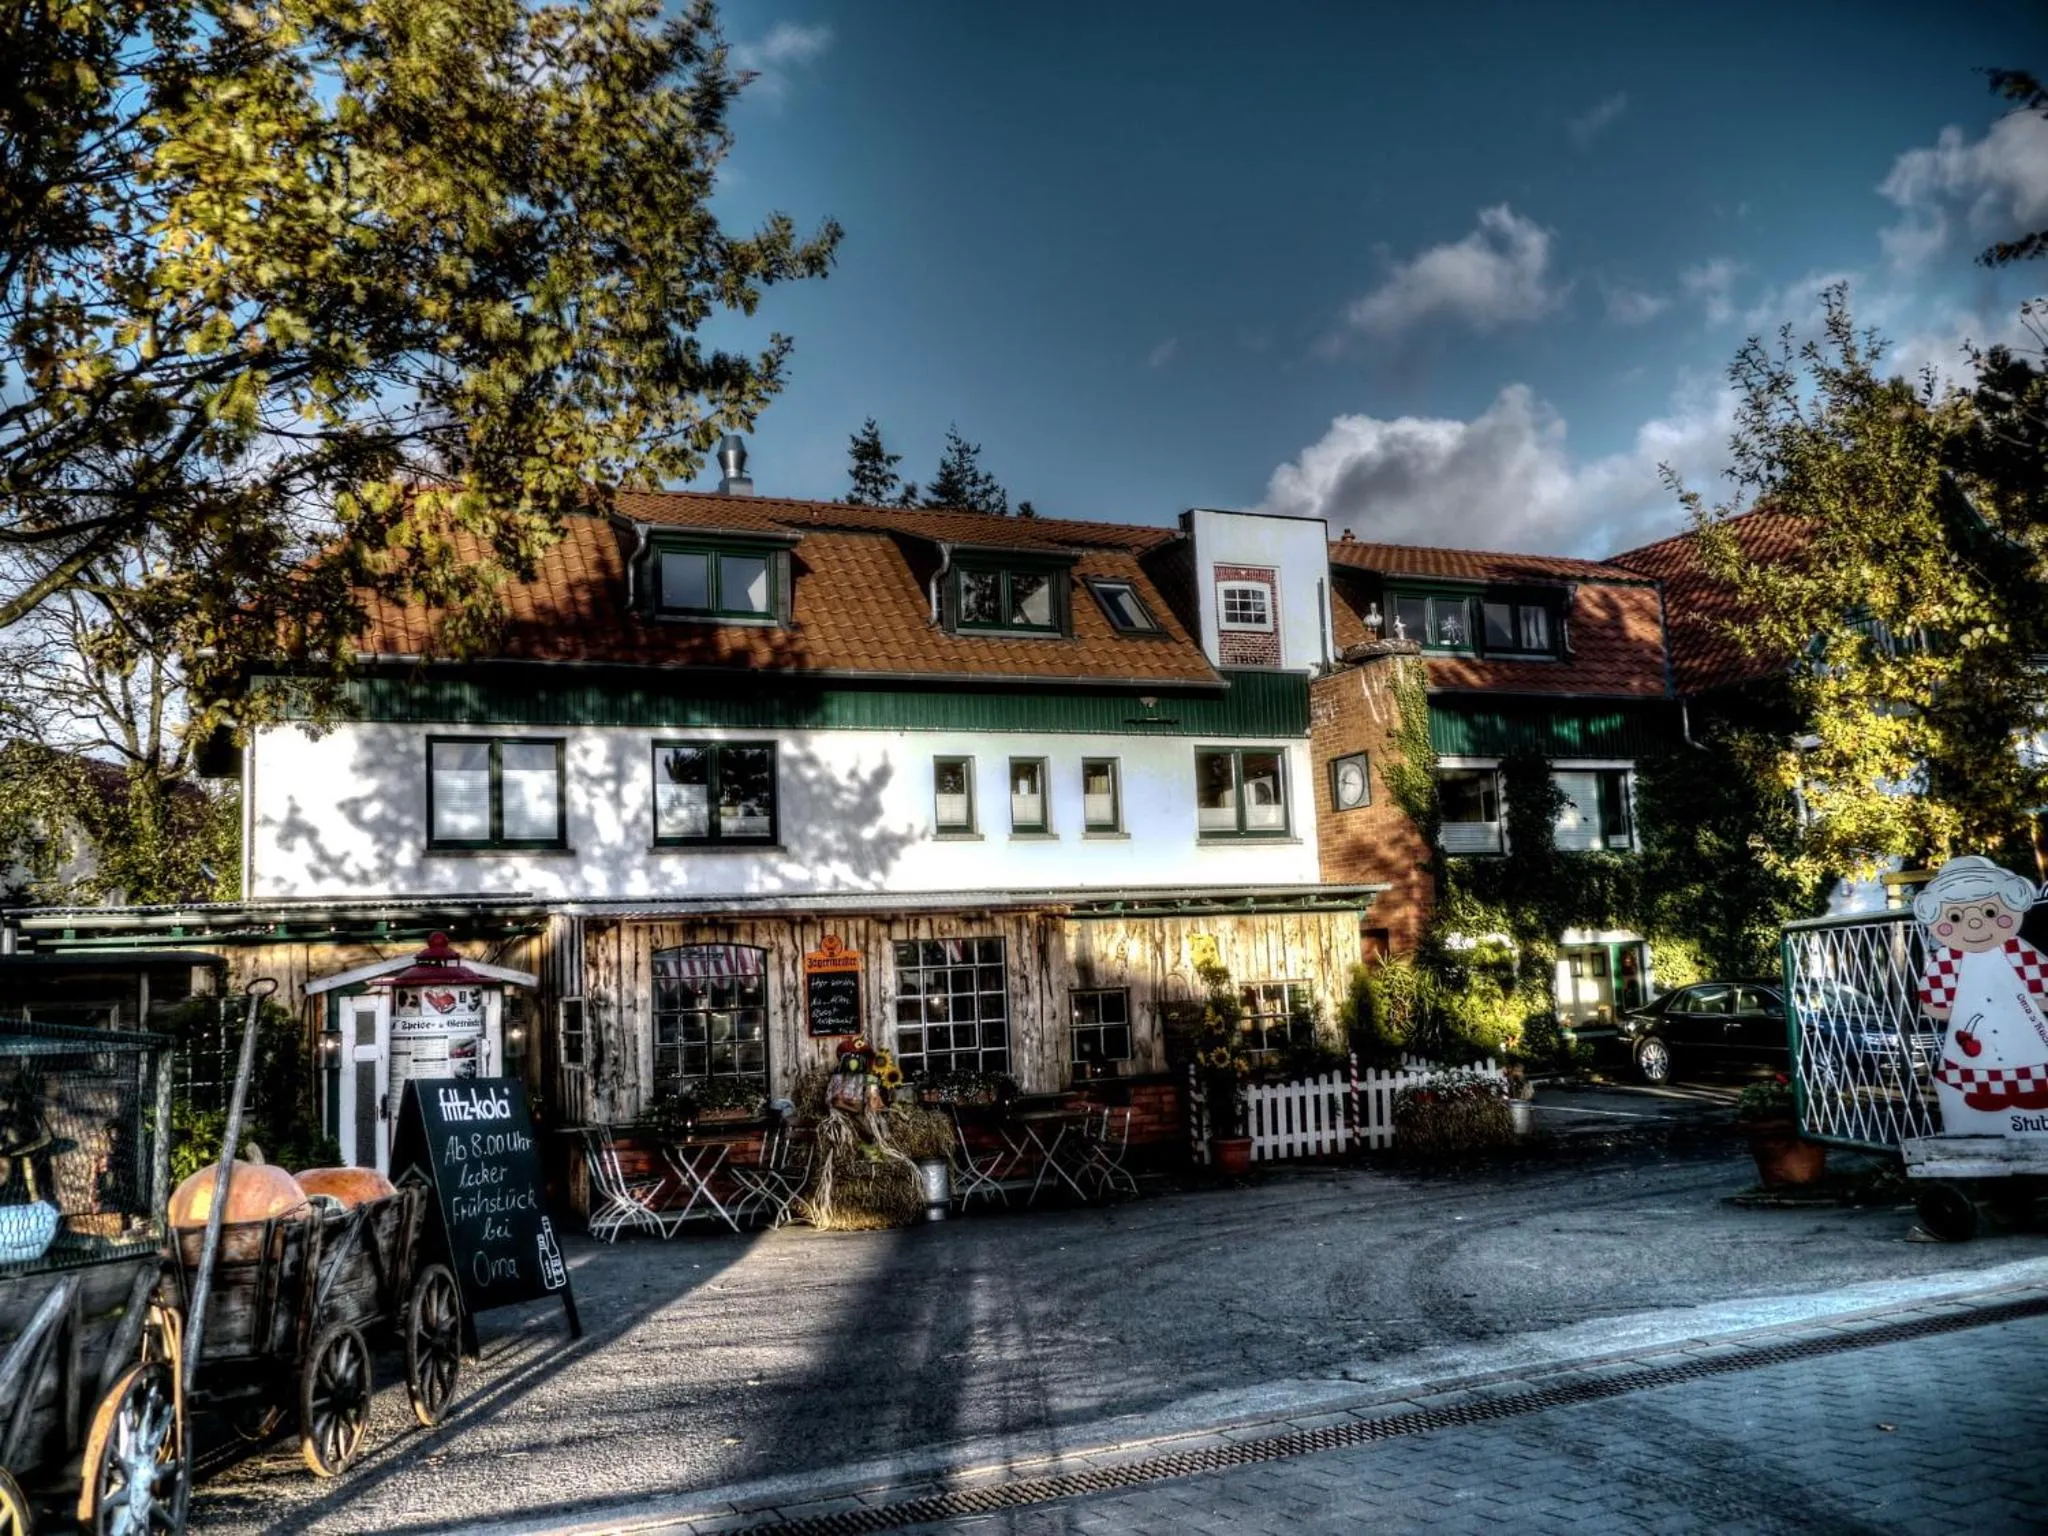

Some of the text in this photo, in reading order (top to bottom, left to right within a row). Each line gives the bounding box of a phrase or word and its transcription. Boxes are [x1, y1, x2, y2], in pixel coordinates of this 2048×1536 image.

[444, 1129, 534, 1167] Ab 8.00 Uhr
[452, 1182, 538, 1226] Frühstück
[482, 1216, 513, 1241] bei
[473, 1250, 520, 1287] Oma
